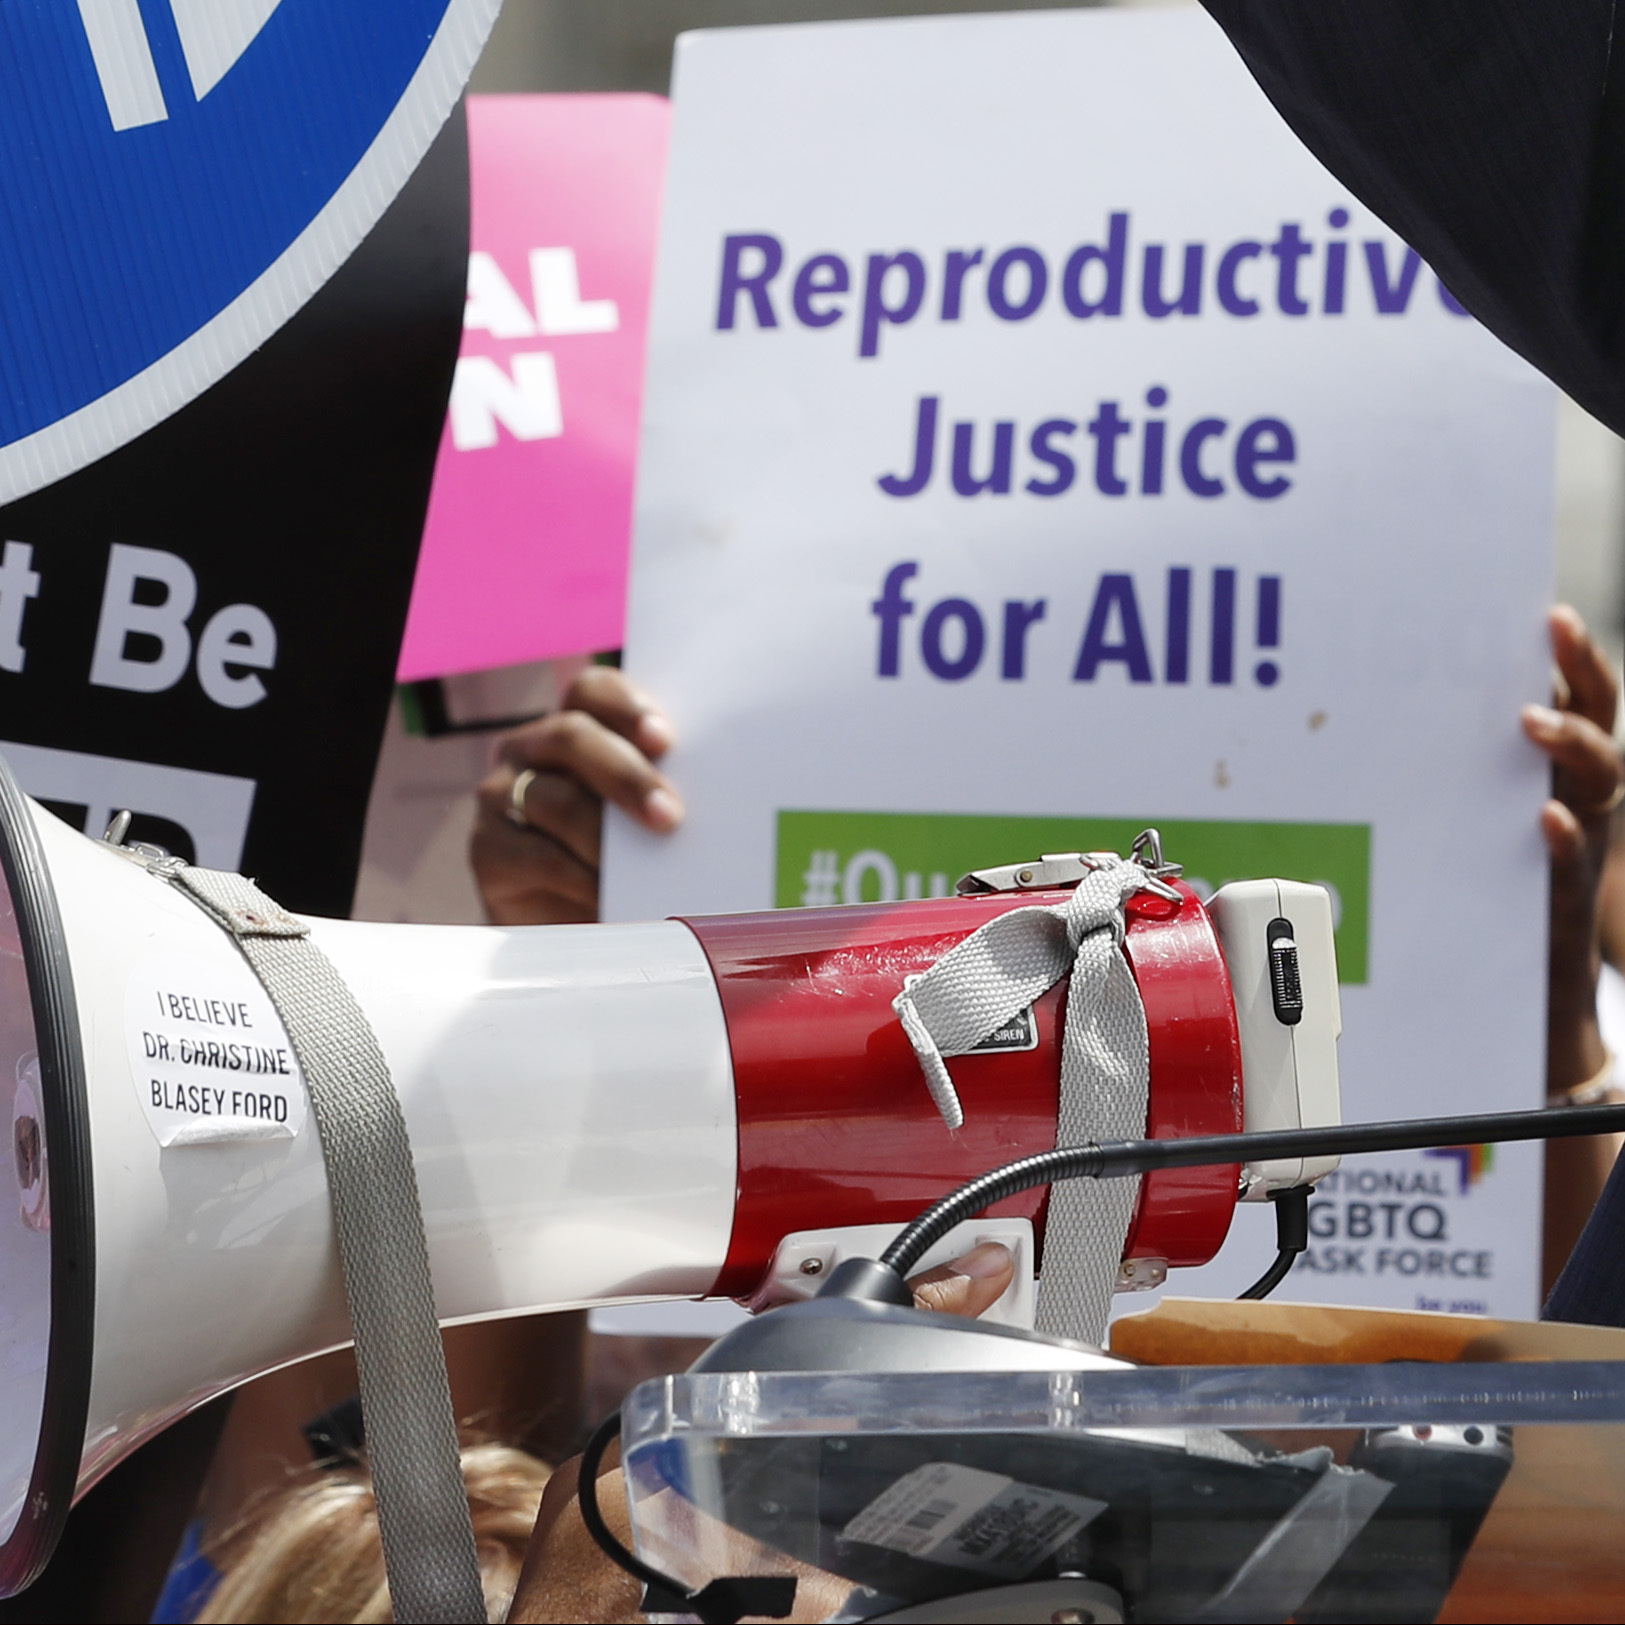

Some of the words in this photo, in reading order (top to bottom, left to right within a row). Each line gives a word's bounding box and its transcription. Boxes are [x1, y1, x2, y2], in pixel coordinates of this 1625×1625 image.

[714, 208, 1472, 358] Reproductiv
[875, 387, 1297, 498] Justice
[87, 541, 279, 710] Be
[869, 562, 1049, 681] for
[1073, 566, 1285, 689] All!
[157, 991, 166, 1017] I
[167, 993, 253, 1028] BELIEVE
[143, 1031, 175, 1062] DR.
[180, 1039, 291, 1075] CHRISTINE
[993, 1028, 1024, 1042] SIREN
[150, 1079, 226, 1116] BLASEY
[232, 1091, 288, 1123] FORD
[1308, 1201, 1447, 1241] GBTQ
[1295, 1246, 1364, 1274] ASK
[1377, 1247, 1493, 1278] FORCE
